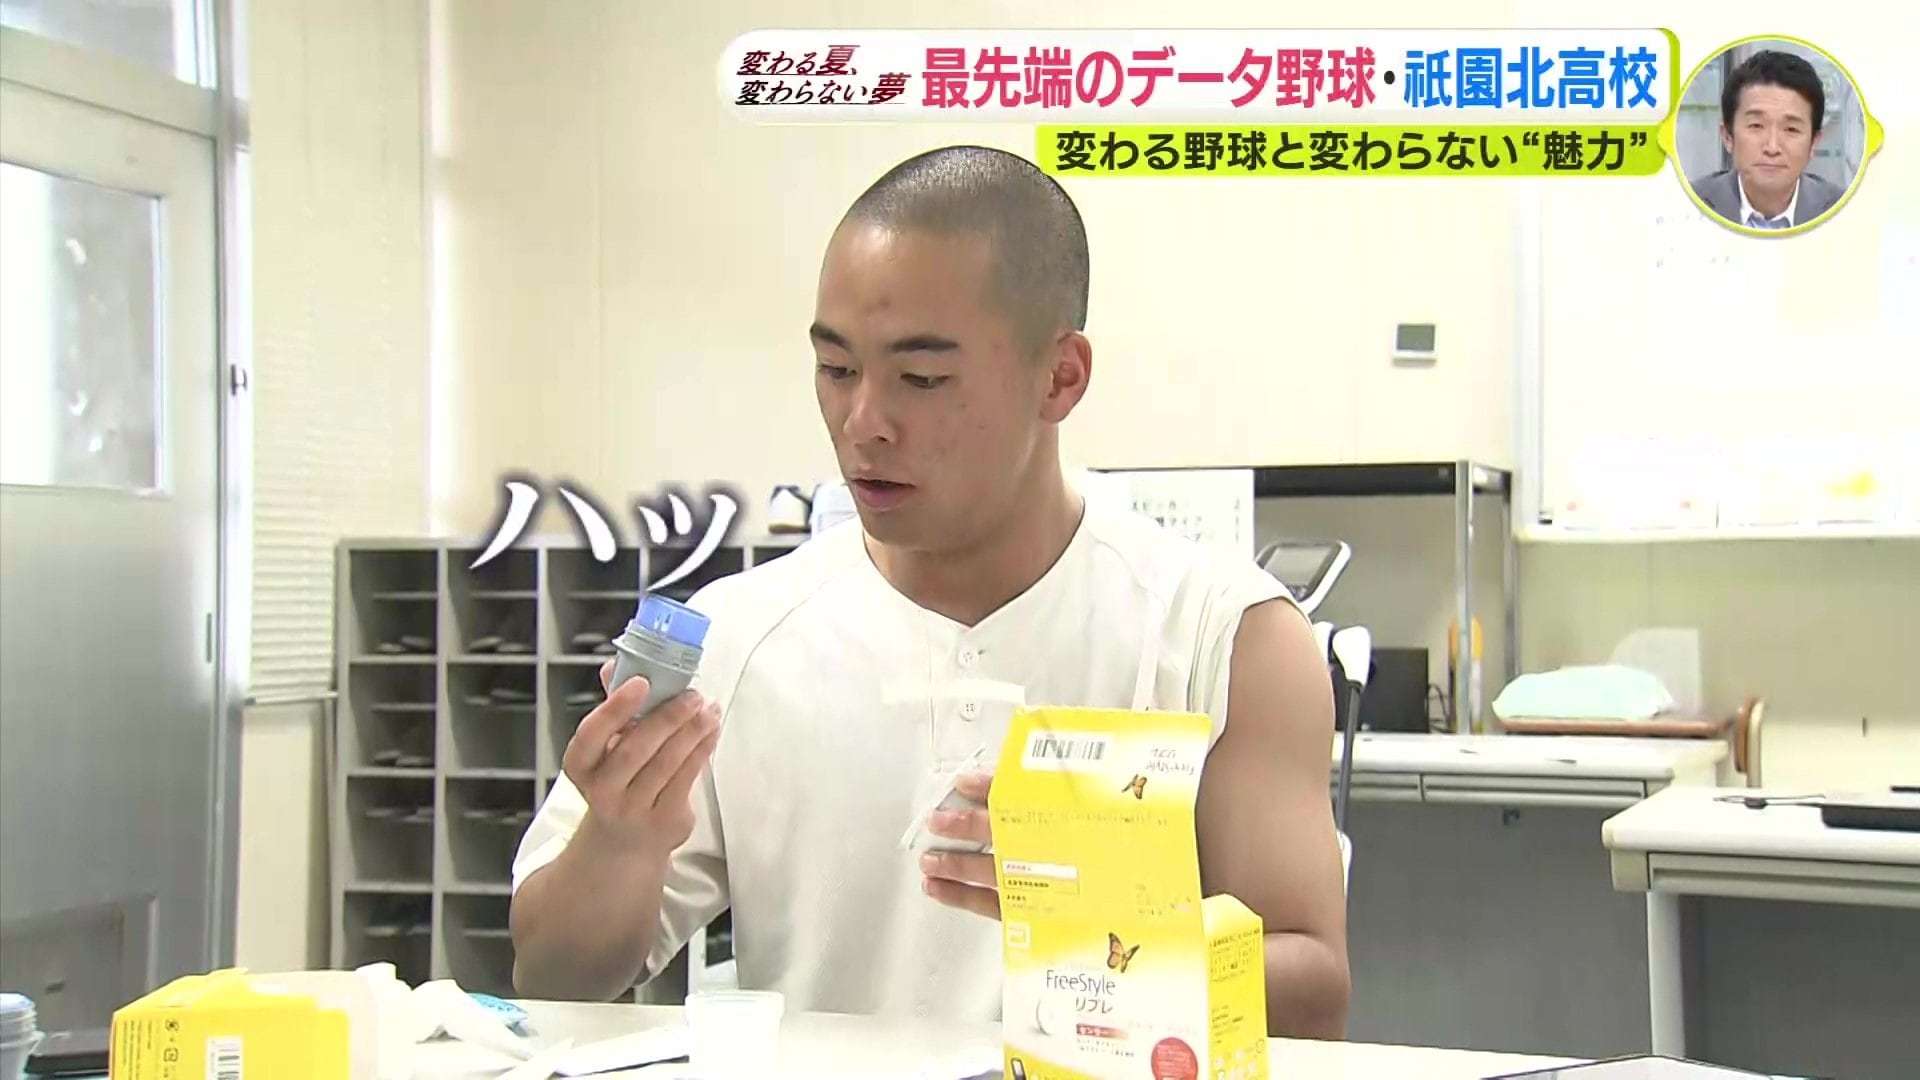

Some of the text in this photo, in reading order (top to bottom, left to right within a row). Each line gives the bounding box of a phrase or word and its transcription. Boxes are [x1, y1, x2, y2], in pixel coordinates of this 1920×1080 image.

[1046, 969, 1116, 997] FreeStyle
[1075, 997, 1114, 1014] リブレ
